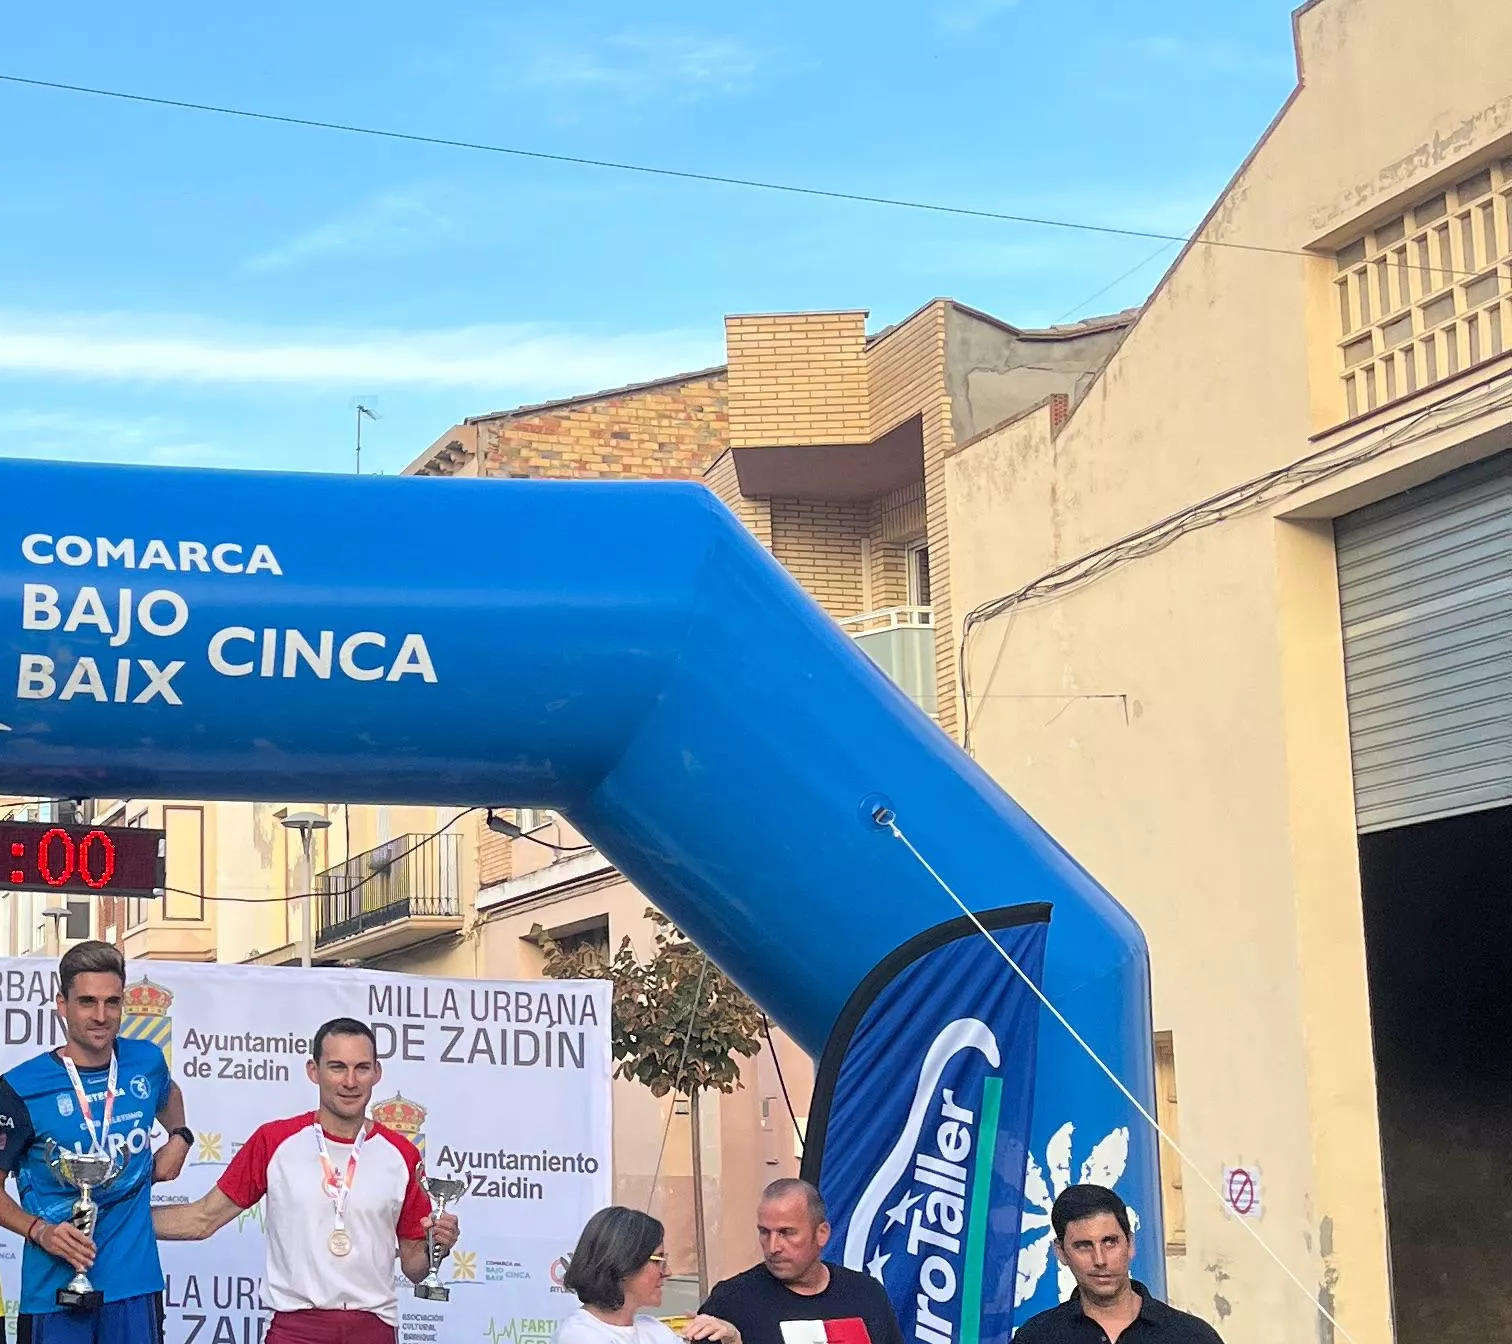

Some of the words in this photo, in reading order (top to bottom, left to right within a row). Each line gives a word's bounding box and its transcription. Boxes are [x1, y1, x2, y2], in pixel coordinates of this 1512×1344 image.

[21, 533, 283, 576] COMARCA
[22, 583, 189, 647] BAJO
[207, 625, 439, 683] CINCA
[16, 653, 186, 706] BAIX
[368, 984, 460, 1020] MILLA
[470, 989, 598, 1026] URBANA
[183, 1027, 313, 1055] Ayuntamie
[370, 1022, 425, 1061] DE
[440, 1018, 585, 1069] ZAIDÍN
[183, 1058, 212, 1079] de
[218, 1057, 289, 1082] Zaidin
[437, 1145, 599, 1174] Ayuntamiento
[472, 1175, 543, 1200] Zaidin
